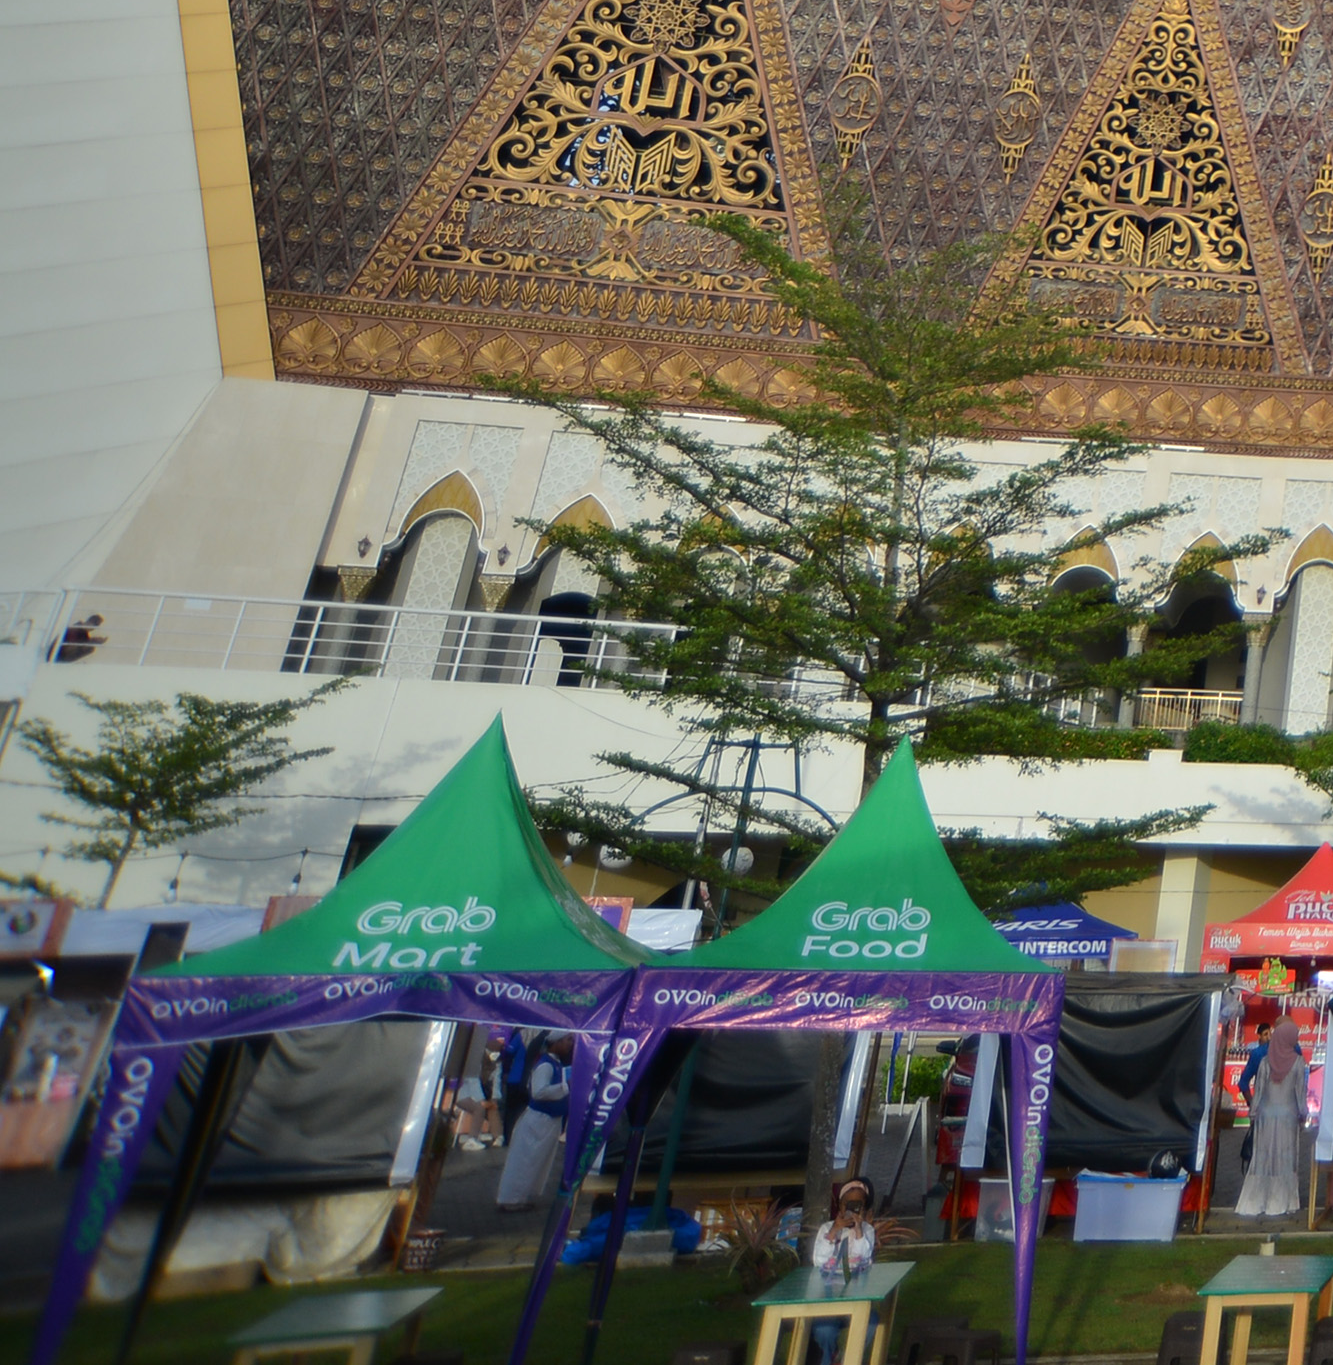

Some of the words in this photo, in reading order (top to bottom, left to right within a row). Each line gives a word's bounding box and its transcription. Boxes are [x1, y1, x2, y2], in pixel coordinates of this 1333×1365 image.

[357, 896, 497, 935] Grab
[812, 898, 931, 932] Grab
[992, 918, 1083, 932] ARIS
[332, 941, 483, 969] Mart
[801, 933, 928, 959] Food
[1019, 940, 1107, 954] INTERCOM
